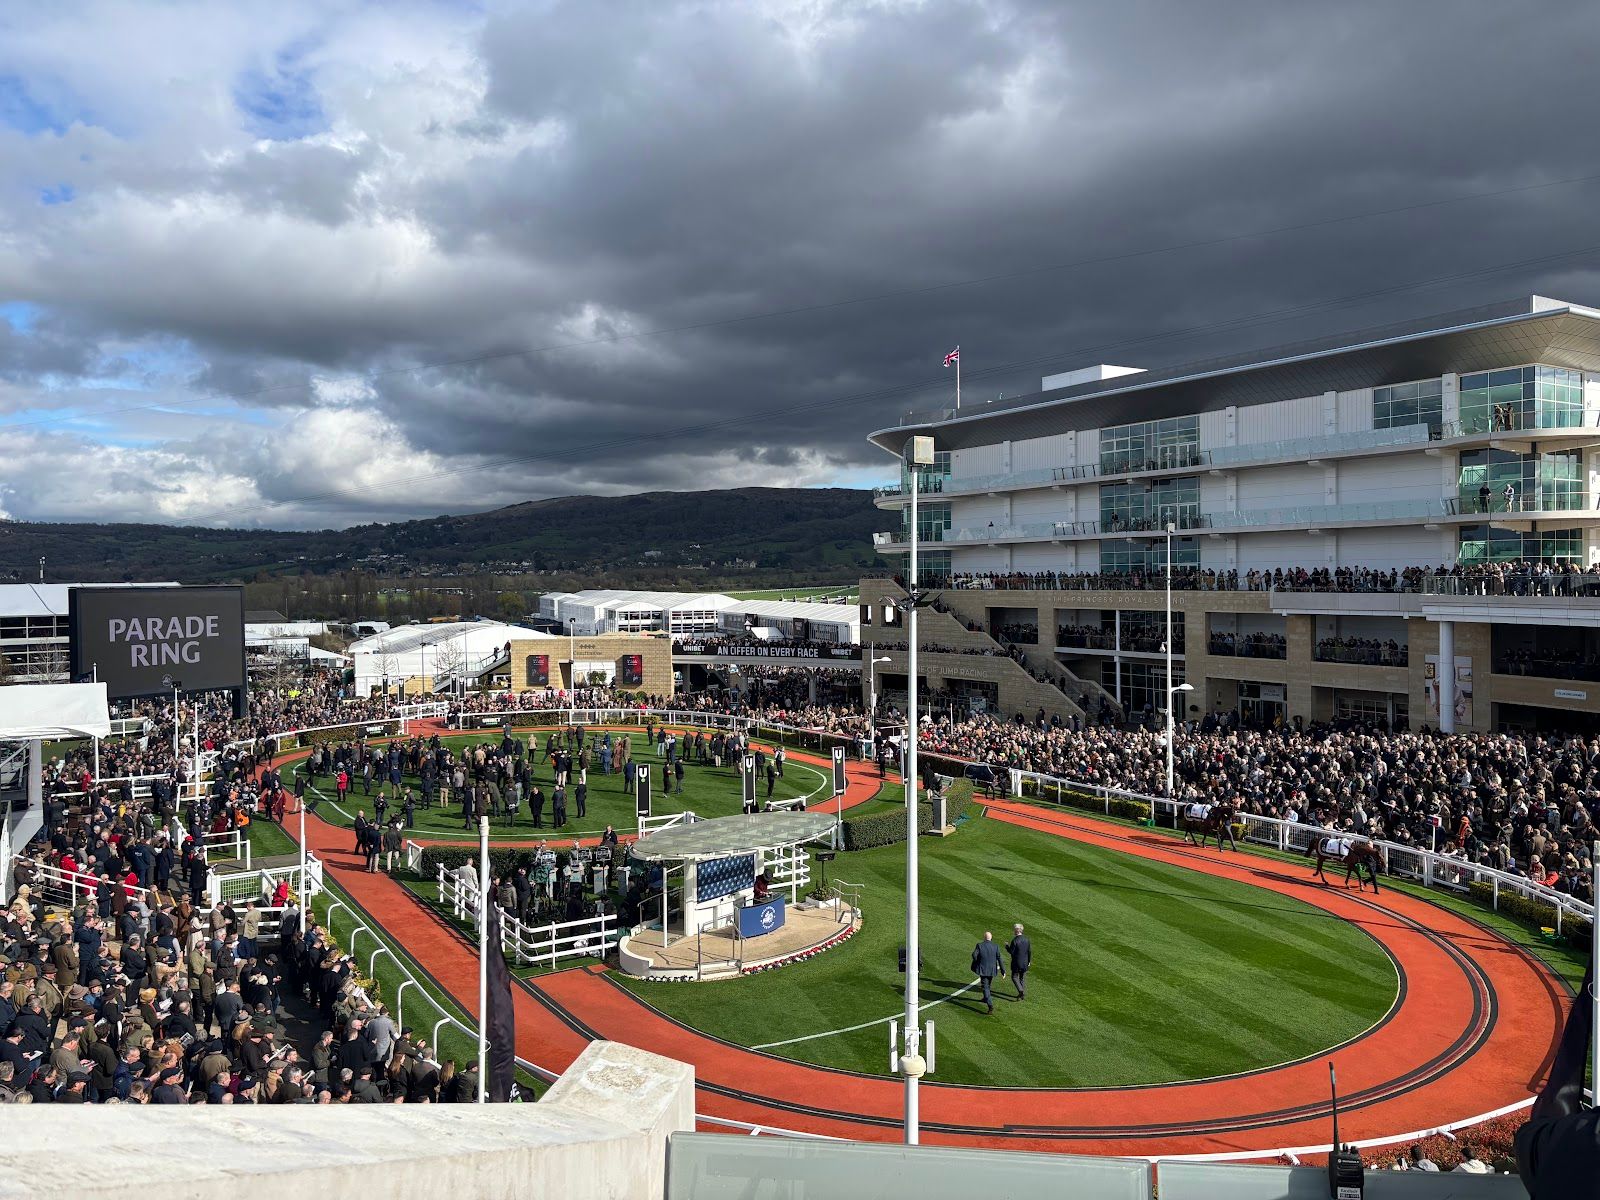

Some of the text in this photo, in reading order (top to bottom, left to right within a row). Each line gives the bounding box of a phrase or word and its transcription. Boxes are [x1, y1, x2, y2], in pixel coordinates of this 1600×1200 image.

[1153, 597, 1184, 605] STND
[109, 616, 219, 642] PARADE
[131, 641, 200, 667] RING
[717, 646, 729, 656] AN
[757, 646, 769, 656] ON
[770, 647, 796, 656] EVERY
[797, 648, 819, 657] RACE
[903, 665, 925, 673] HE
[926, 665, 938, 673] OF
[939, 667, 959, 675] JUMP
[959, 668, 988, 678] RACING
[835, 749, 843, 760] U
[745, 757, 753, 769] U
[639, 767, 648, 778] U
